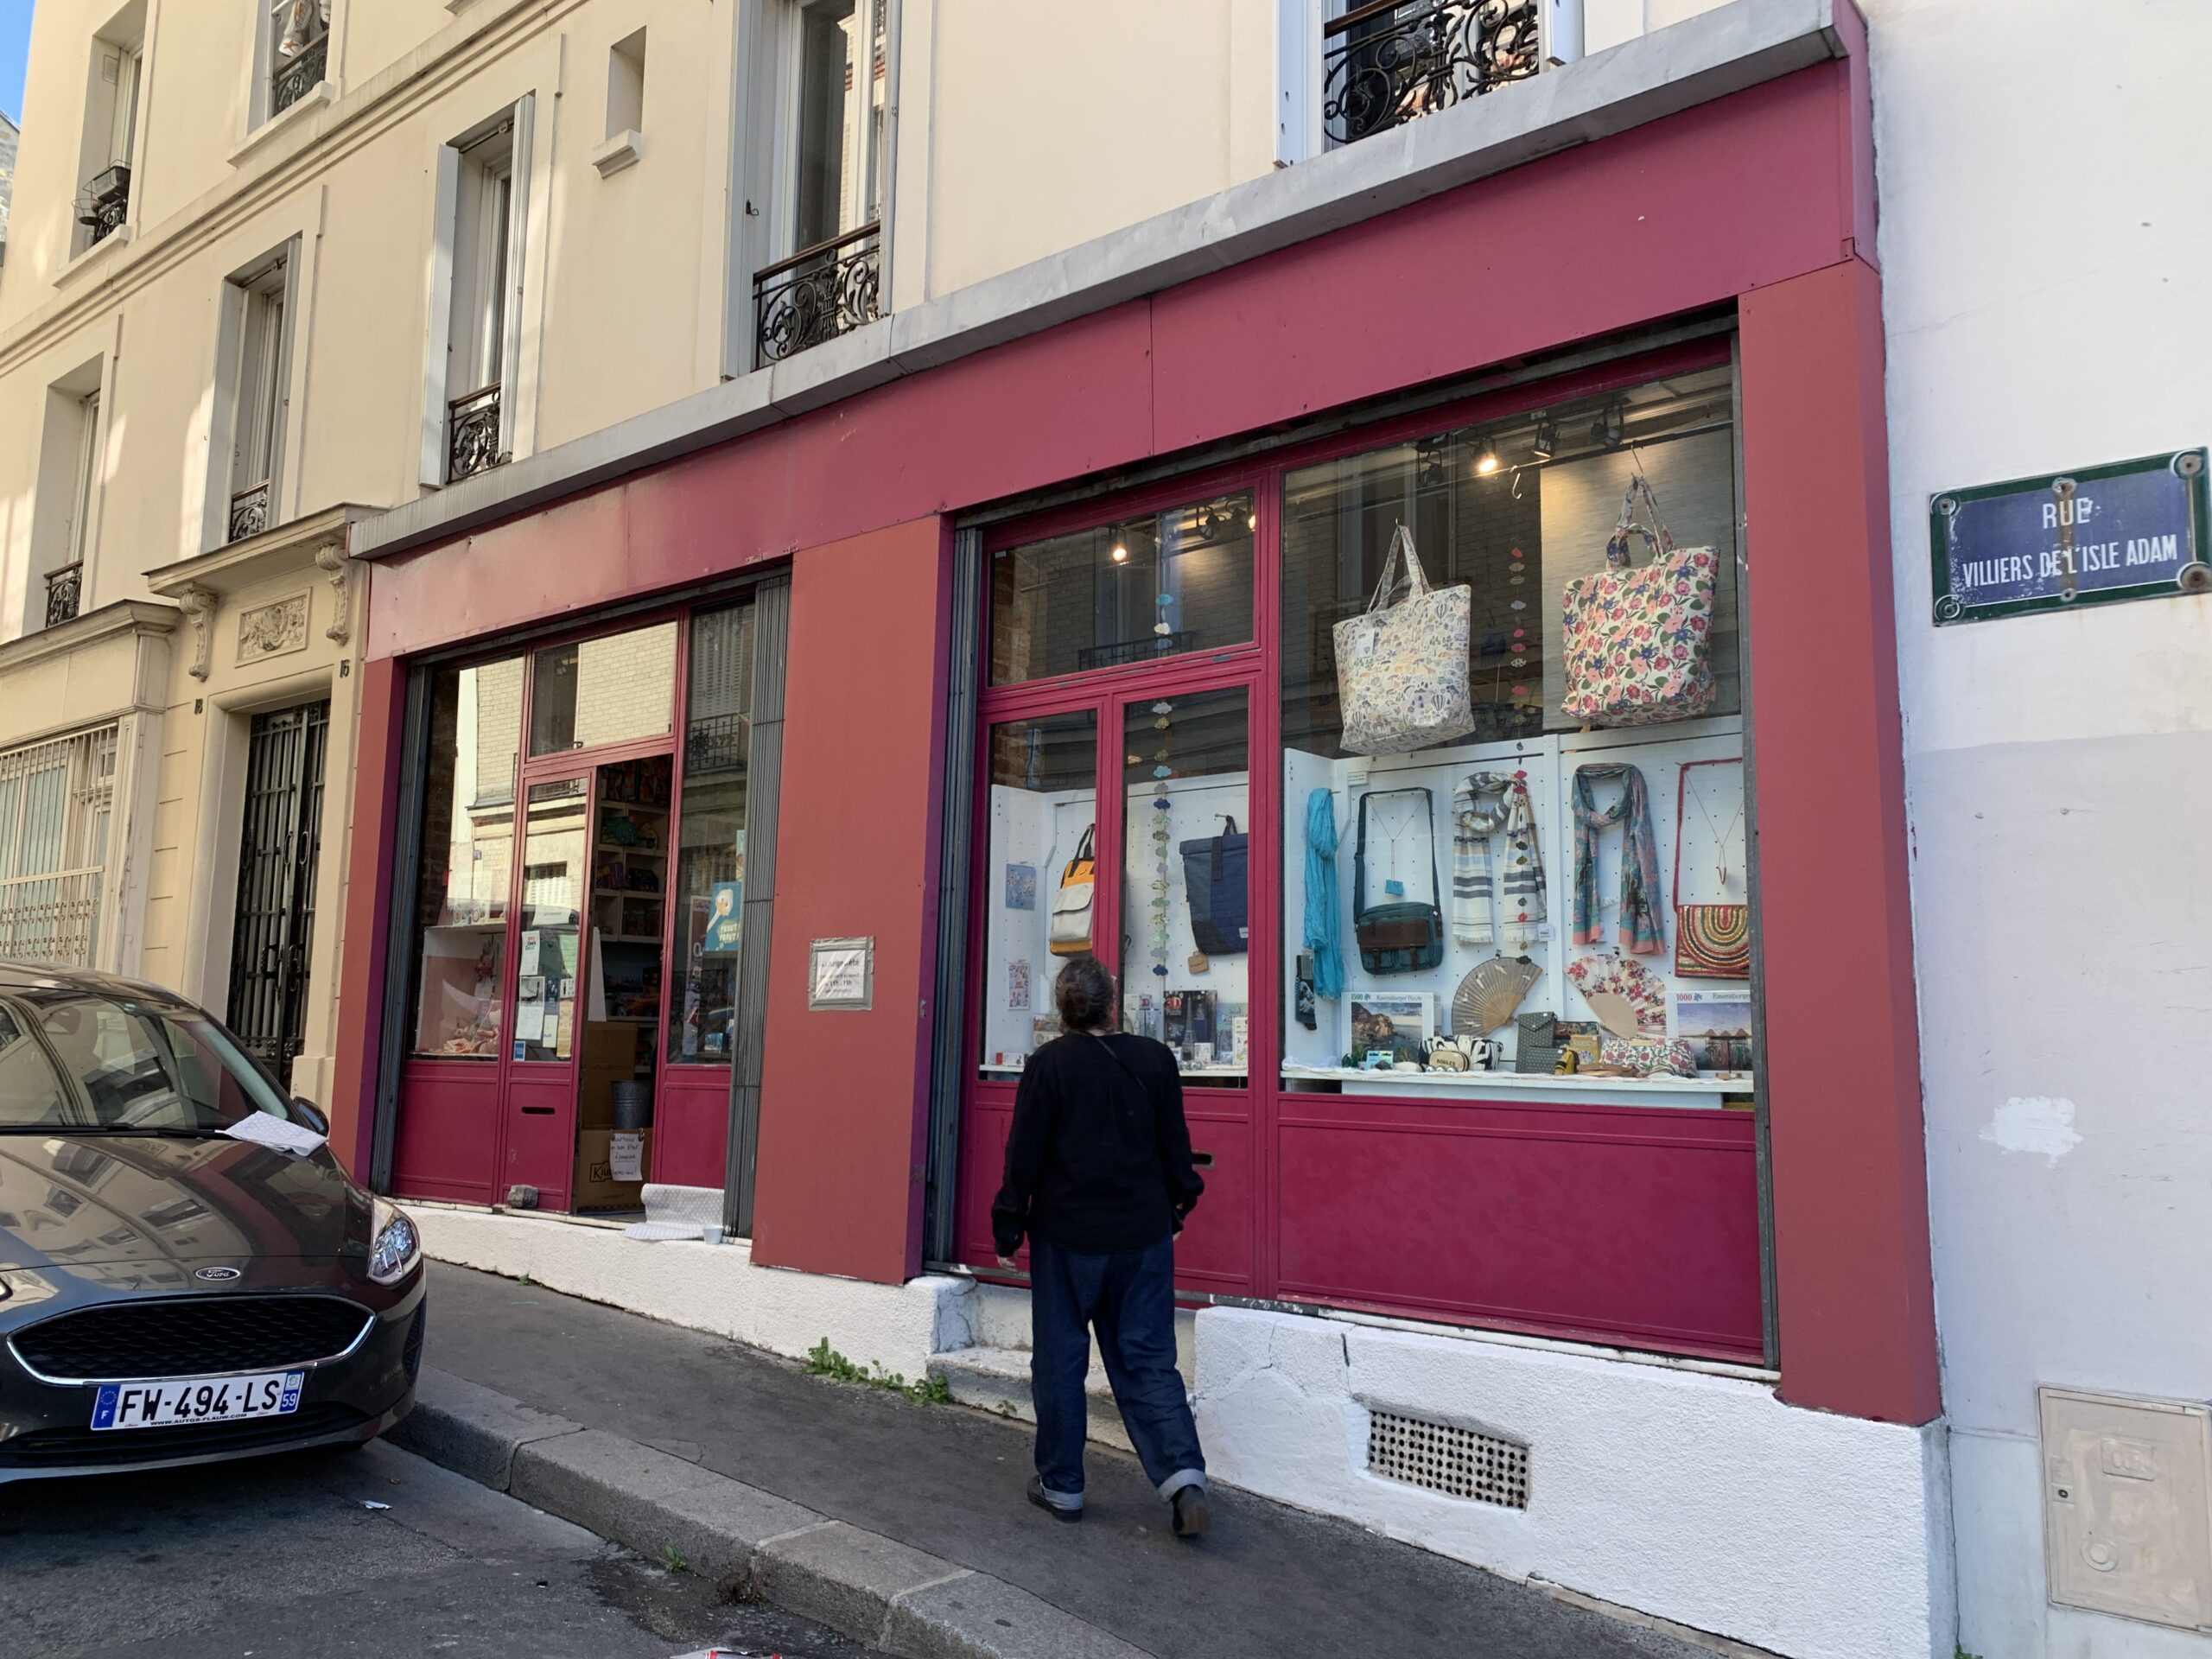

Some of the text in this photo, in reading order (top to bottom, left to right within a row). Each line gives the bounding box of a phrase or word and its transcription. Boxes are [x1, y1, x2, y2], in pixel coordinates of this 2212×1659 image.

[2042, 497, 2091, 529] RUE
[1962, 533, 2177, 588] VILLIERS DE L'ISLE ADAM
[1713, 991, 1751, 1001] Ravensburge
[207, 1269, 230, 1278] Ford
[118, 1380, 280, 1423] FW-494-LS
[282, 1392, 297, 1408] 59
[101, 1410, 110, 1421] F
[149, 1412, 248, 1427] WWW.AUTOS-FLAUW.COM
